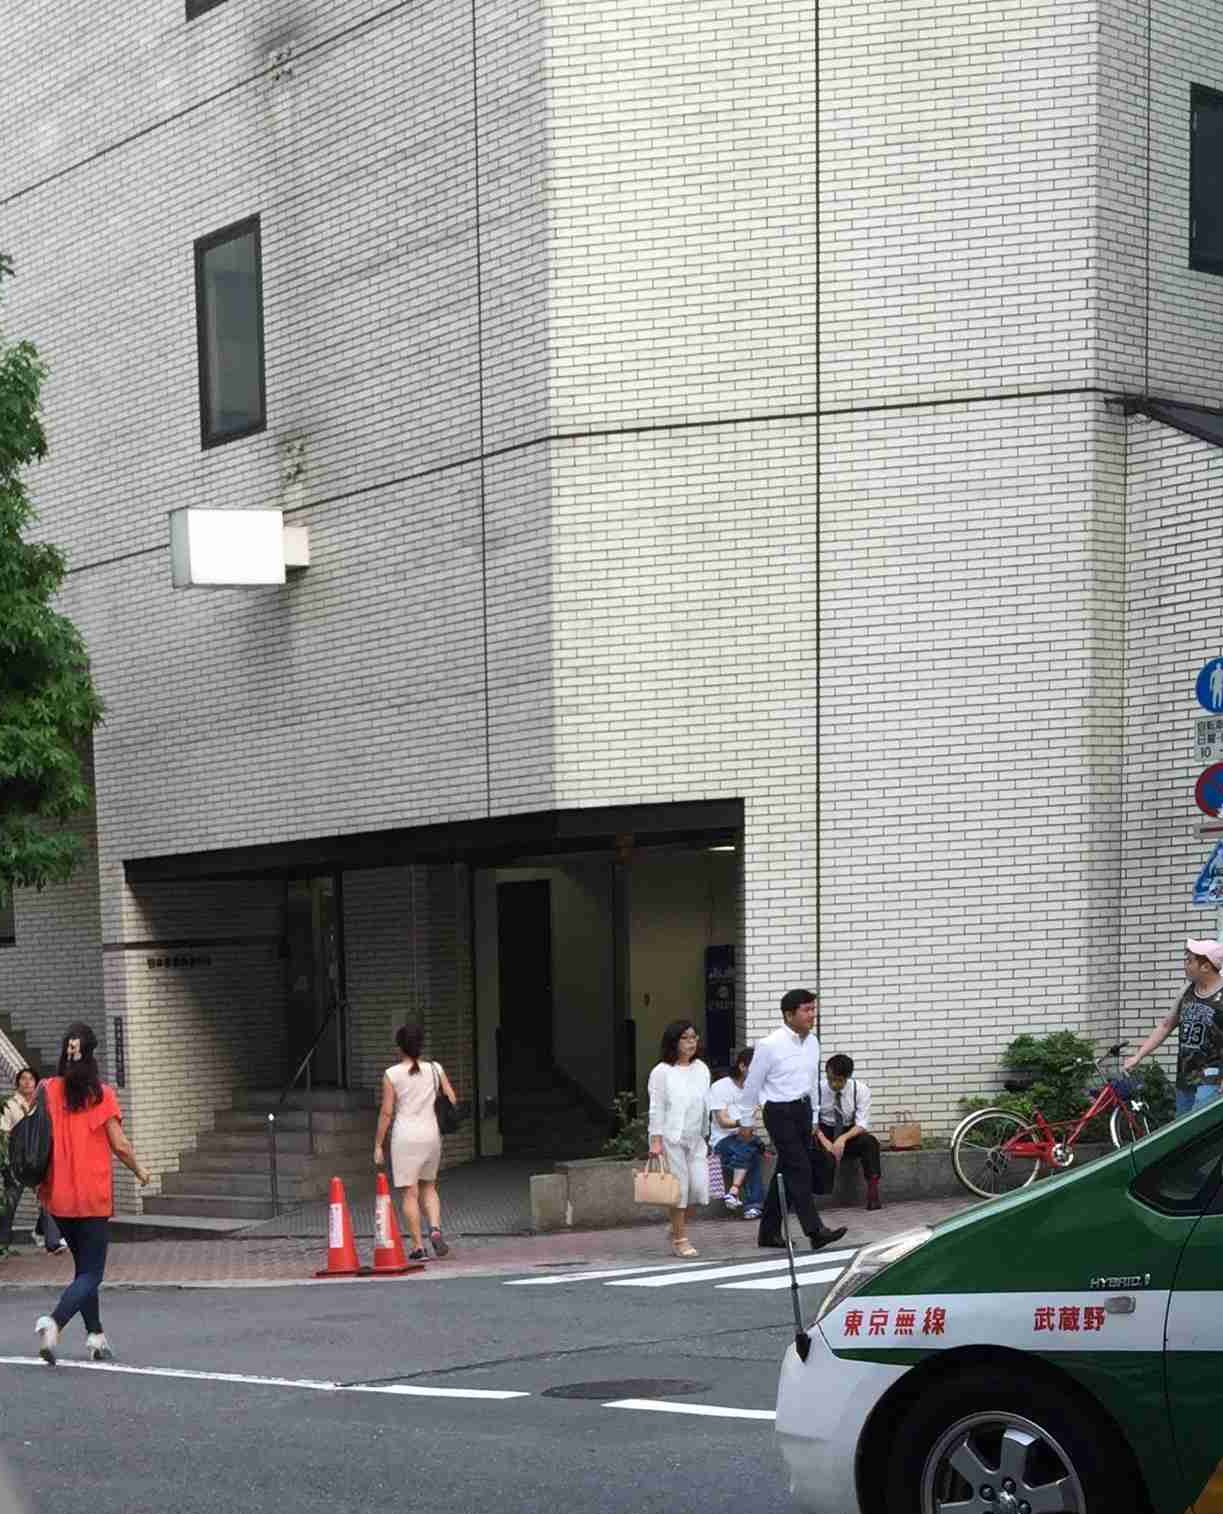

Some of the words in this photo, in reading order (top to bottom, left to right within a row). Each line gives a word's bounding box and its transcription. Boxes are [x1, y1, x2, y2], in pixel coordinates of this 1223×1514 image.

[1090, 1275, 1142, 1289] HYBRID
[842, 1306, 947, 1337] 東京無線
[1033, 1305, 1106, 1333] 武蔵野
